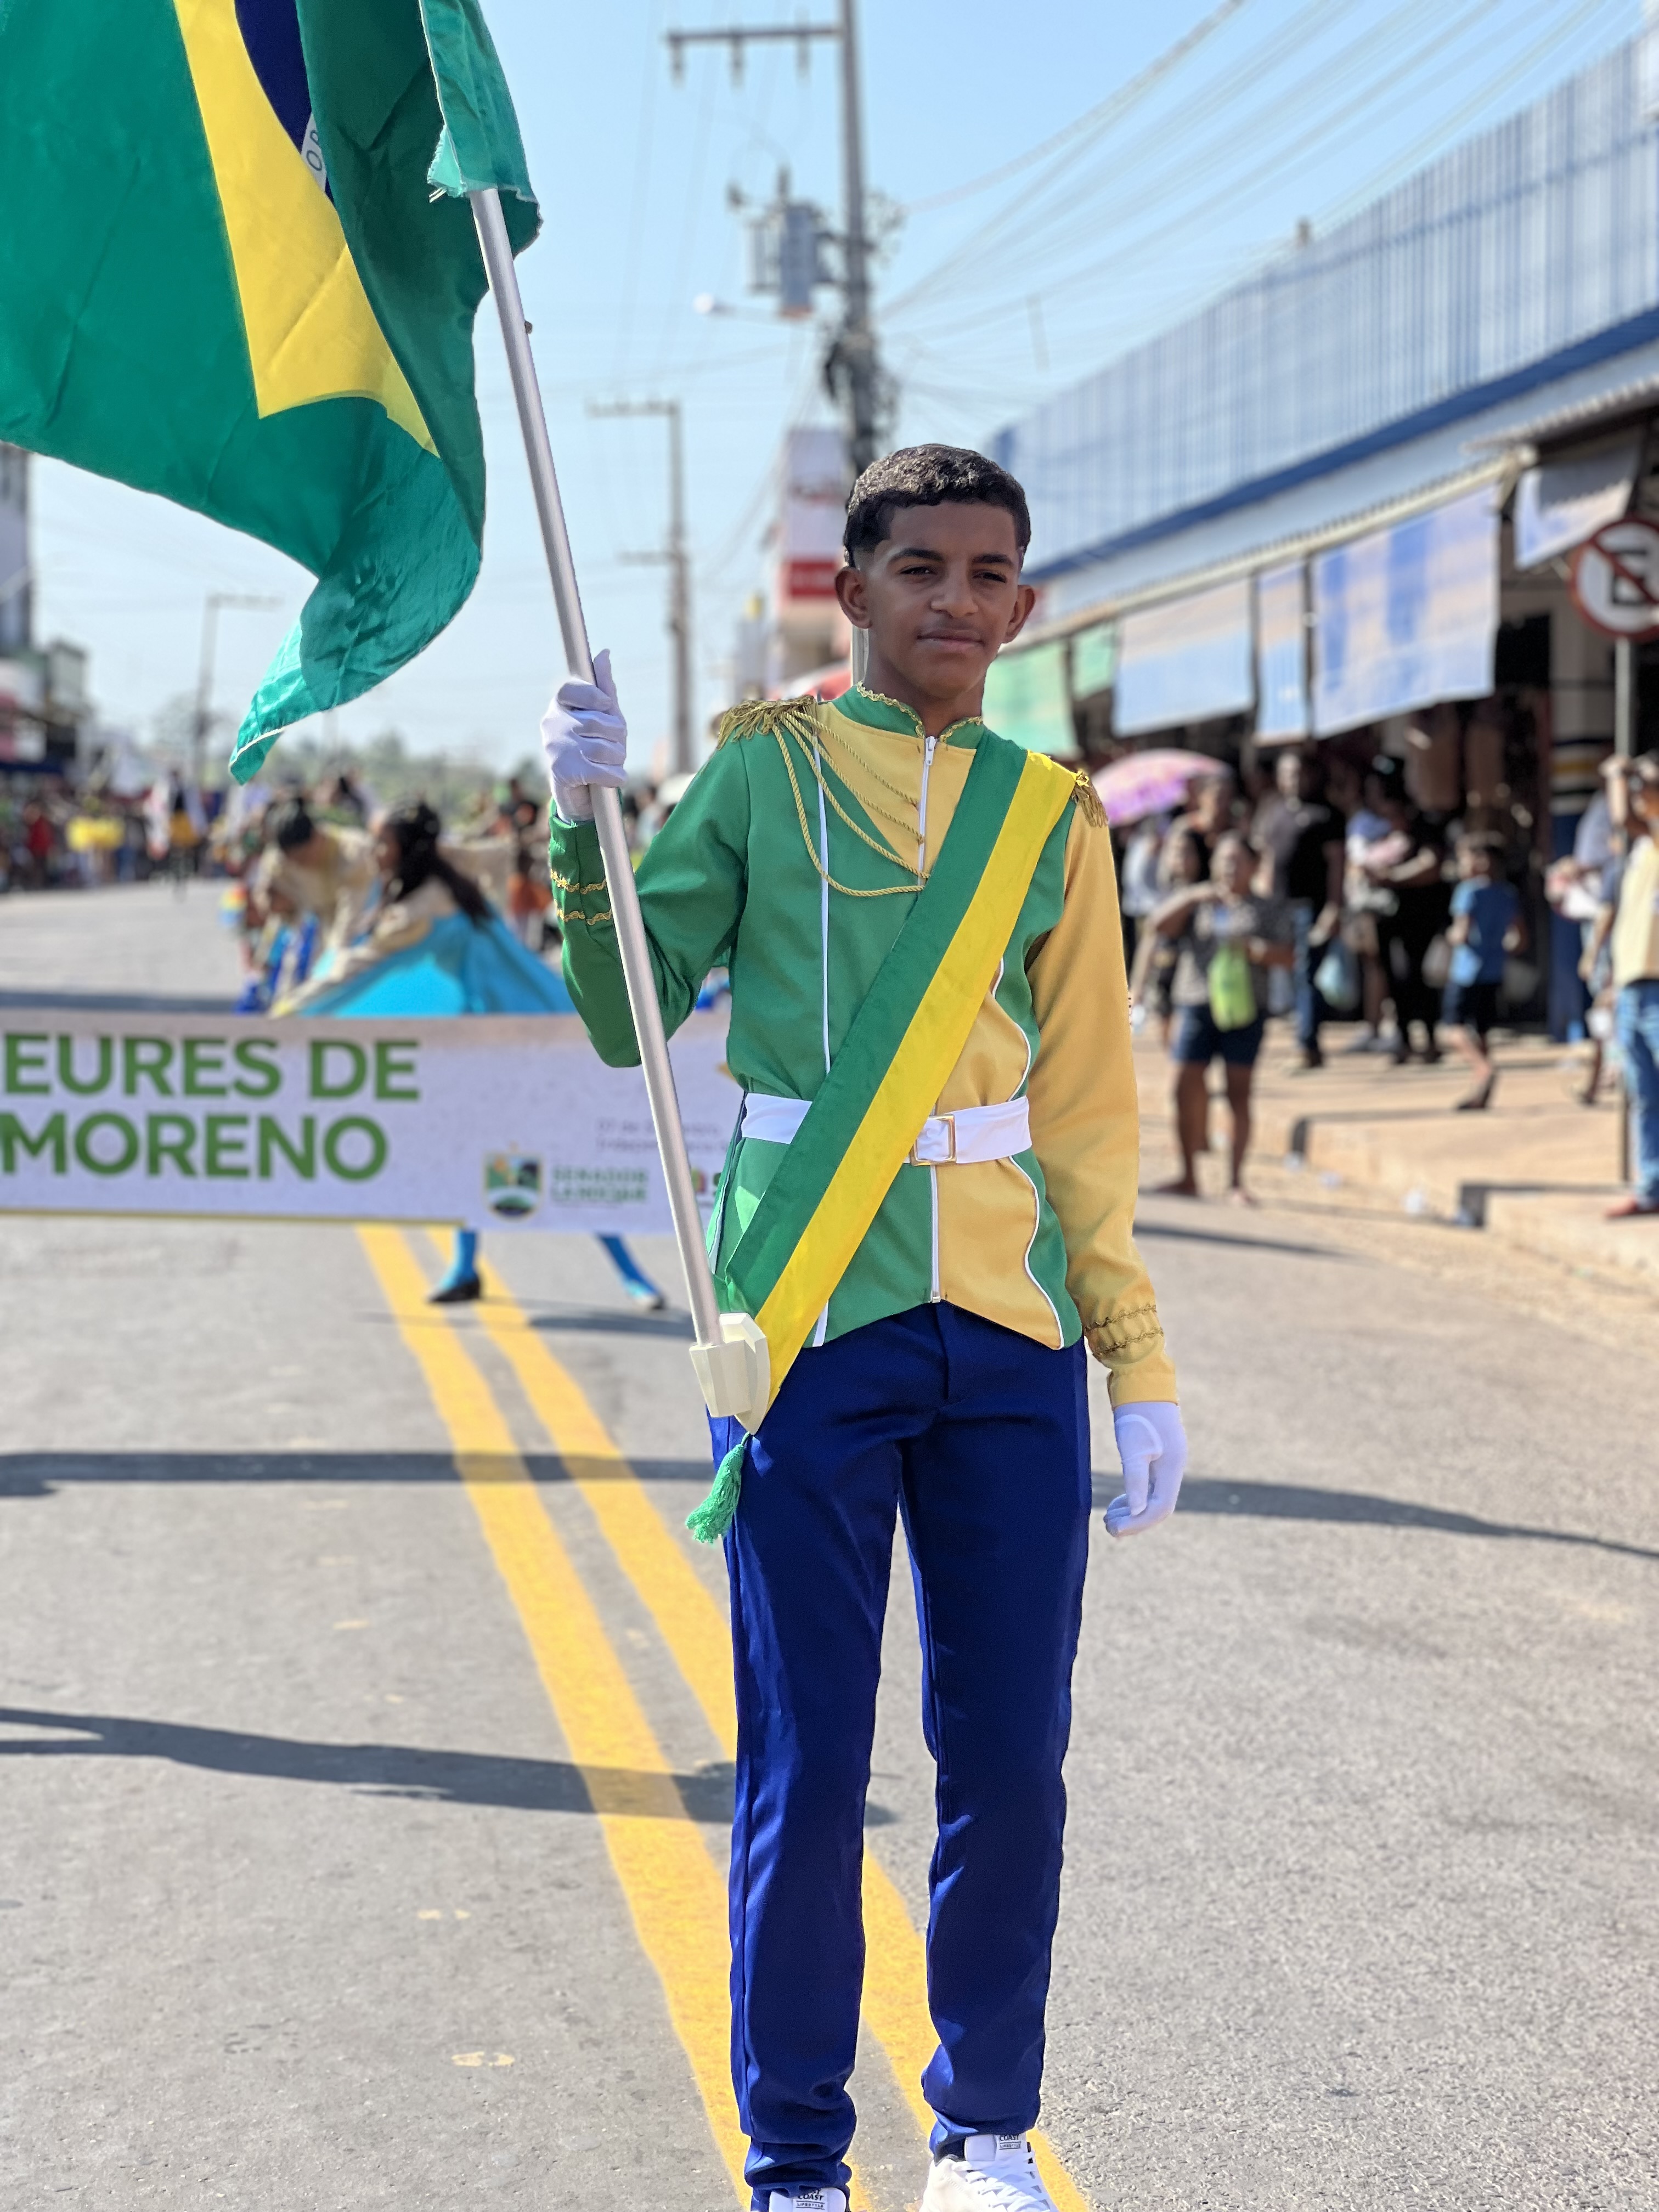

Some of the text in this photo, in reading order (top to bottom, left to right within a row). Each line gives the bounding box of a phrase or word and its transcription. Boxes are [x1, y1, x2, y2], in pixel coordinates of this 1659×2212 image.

[4, 1034, 419, 1101] EURES DE
[1, 1110, 388, 1181] MORENO
